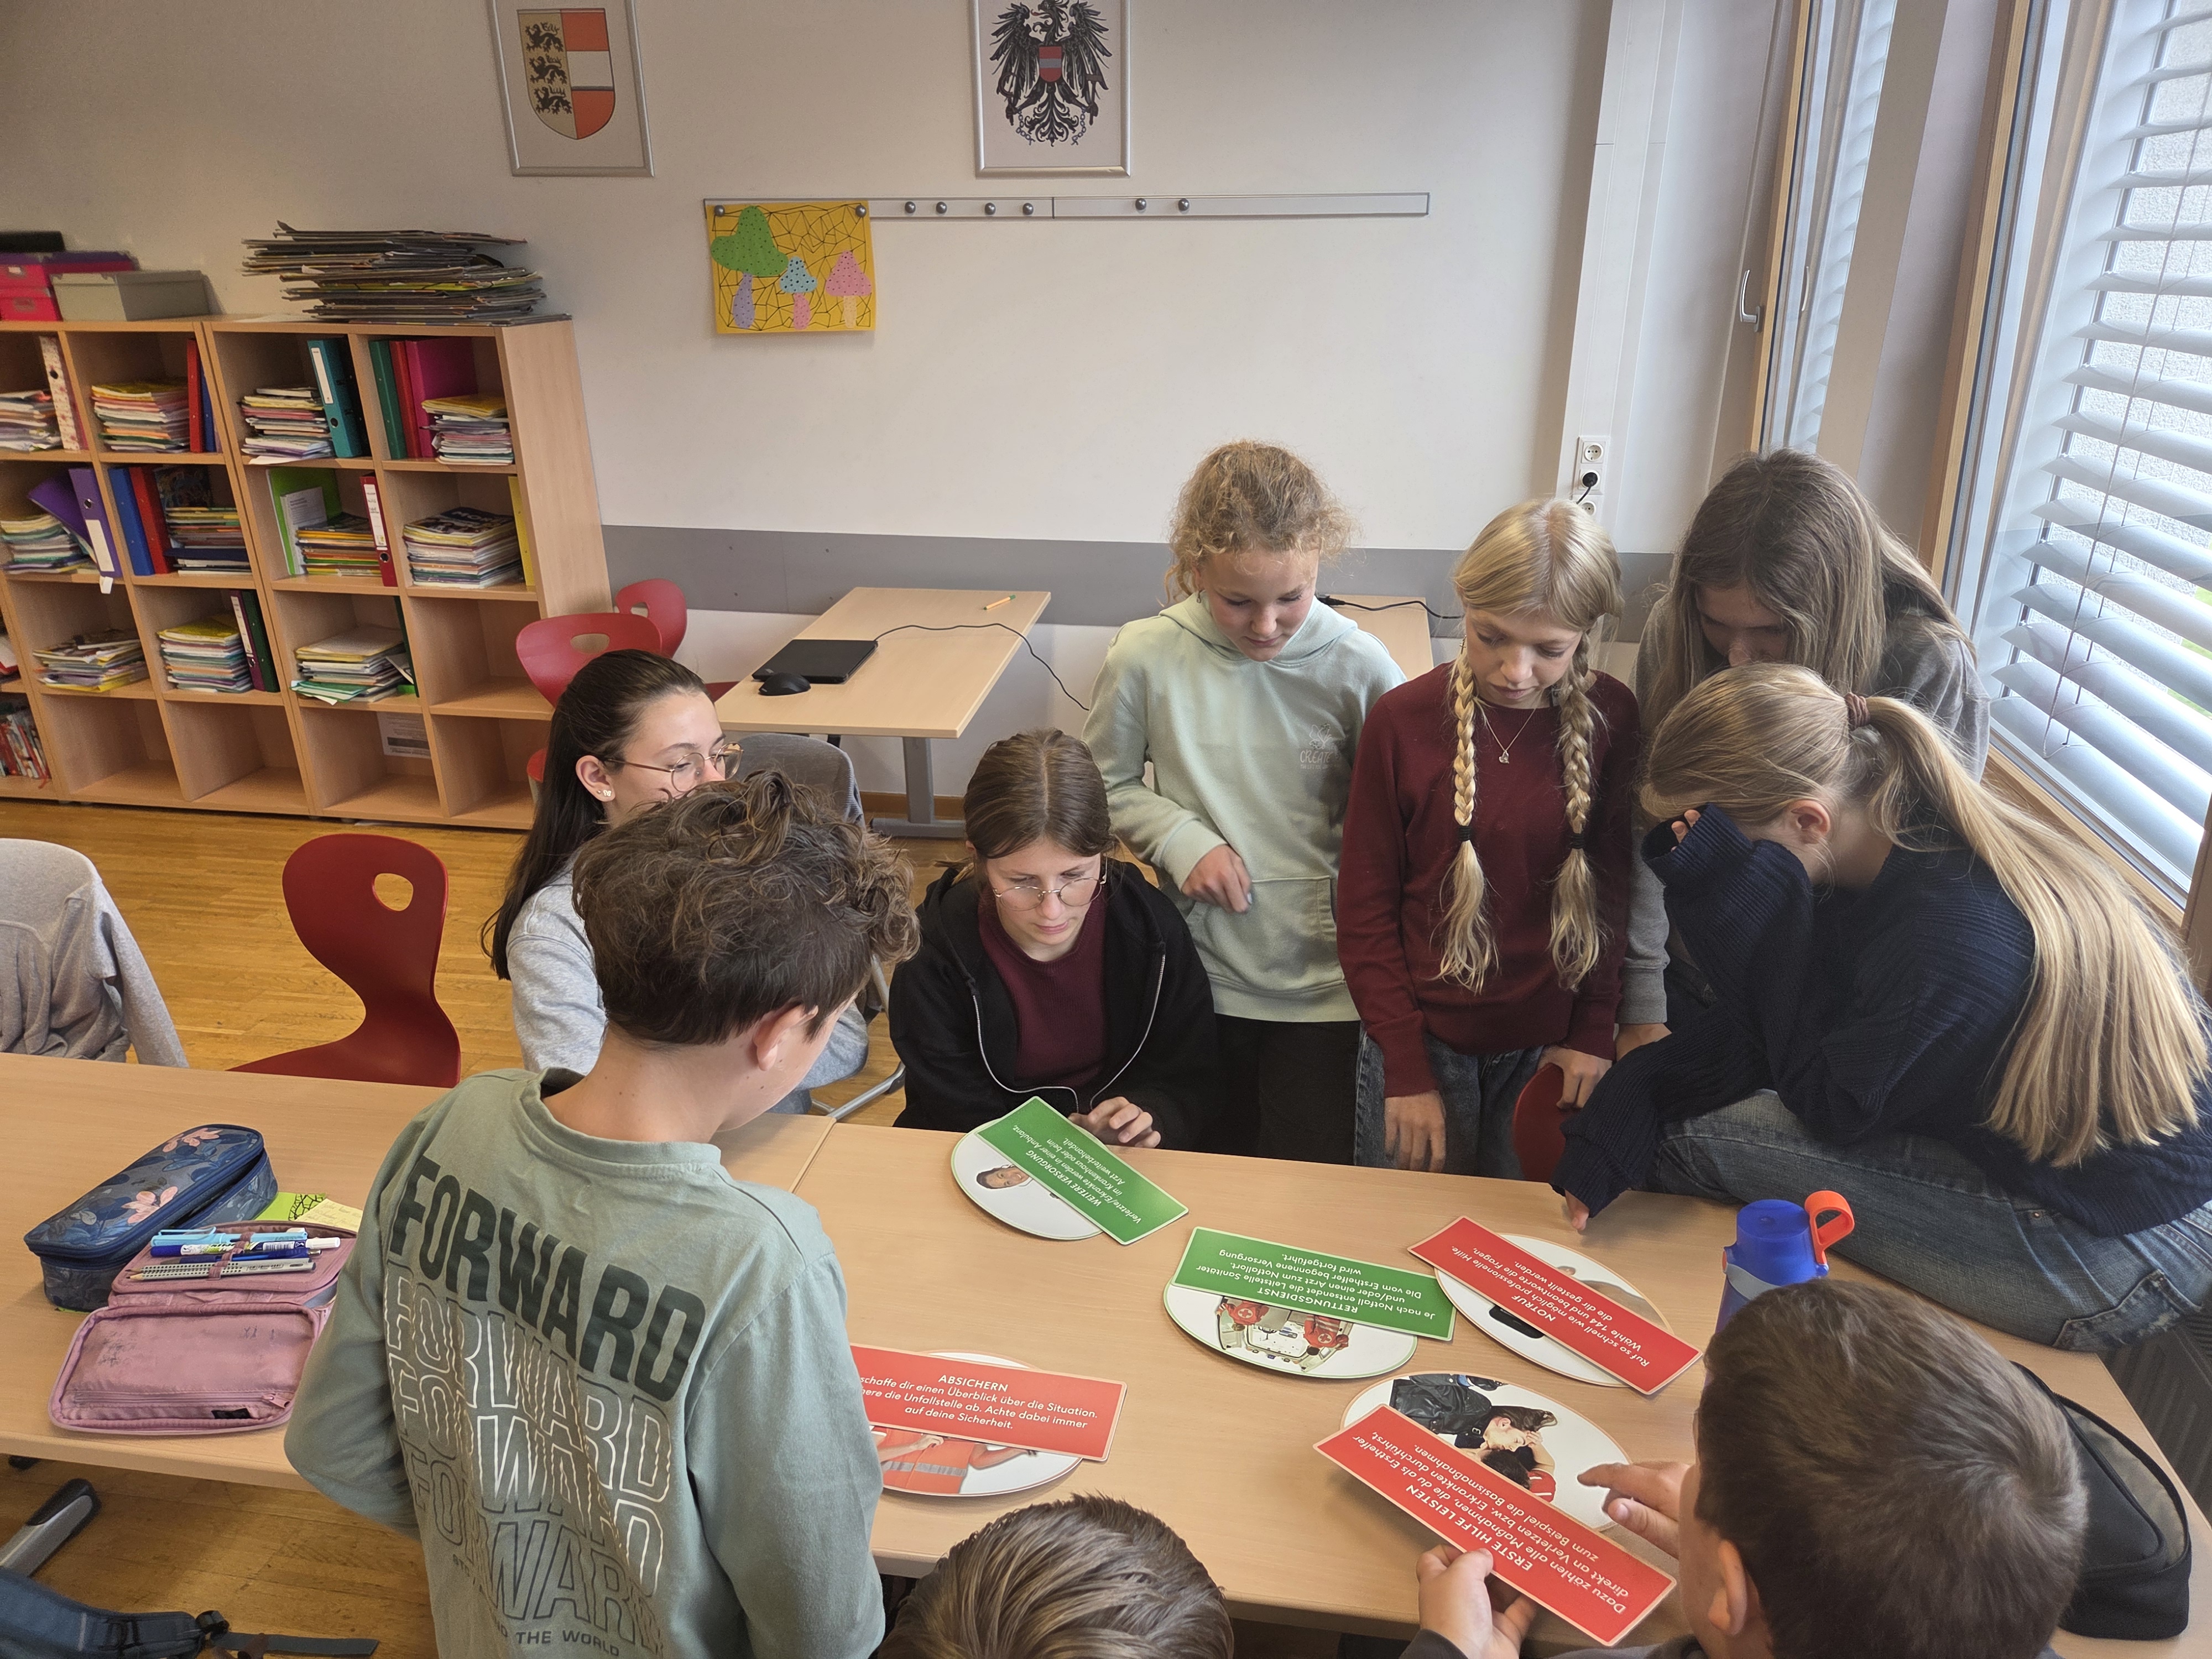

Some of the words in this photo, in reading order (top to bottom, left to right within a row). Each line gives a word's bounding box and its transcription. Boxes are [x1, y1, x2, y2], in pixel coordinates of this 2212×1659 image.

[1300, 749, 1333, 764] CREATE
[1012, 1124, 1043, 1149] Ambulanz,
[1046, 1138, 1063, 1153] beim
[1038, 1146, 1057, 1160] einer
[1054, 1157, 1063, 1165] in
[1060, 1150, 1077, 1162] oder
[1062, 1137, 1112, 1176] weiterbehandelt.
[1025, 1149, 1073, 1186] VERSORGUNG
[1060, 1162, 1084, 1181] werden
[1074, 1160, 1115, 1191] Krankenhaus
[1109, 1173, 1126, 1186] Arzt
[1069, 1182, 1102, 1207] WEITERE
[1082, 1178, 1142, 1224] Verletzte/Erkrankte
[1112, 1187, 1123, 1197] im
[1218, 1249, 1273, 1269] Versorgung
[1281, 1253, 1337, 1272] fortgeführt.
[1451, 1245, 1473, 1262] Hilfe.
[1473, 1247, 1504, 1270] Fragen,
[389, 1155, 706, 1402] FORWARD
[1195, 1265, 1242, 1281] Sanitäter
[1229, 1262, 1280, 1280] Notfallort.
[1275, 1262, 1331, 1281] begonnene
[1281, 1272, 1303, 1282] zum
[1338, 1265, 1362, 1276] wird
[1472, 1259, 1533, 1296] professionelle
[1503, 1266, 1519, 1277] die
[1514, 1261, 1548, 1284] werden.
[1243, 1274, 1287, 1290] Leitstelle
[1288, 1284, 1305, 1293] die
[1304, 1277, 1327, 1288] Arzt
[1328, 1282, 1356, 1293] einen
[1331, 1274, 1380, 1291] Ersthelfer
[1381, 1284, 1404, 1294] vom
[1256, 1286, 1359, 1314] RETTUNGSDIENST
[1306, 1287, 1356, 1302] entsendet
[1356, 1288, 1406, 1303] und/oder
[1405, 1288, 1422, 1300] Die
[1518, 1275, 1571, 1310] beantworte
[1547, 1281, 1584, 1303] gestellt
[1357, 1297, 1394, 1312] Notfall
[1396, 1306, 1422, 1316] nach
[1510, 1295, 1557, 1322] NOTRUF
[1531, 1293, 1568, 1317] möglich
[1568, 1306, 1590, 1319] und
[1580, 1302, 1597, 1312] dir
[1423, 1311, 1436, 1321] Je
[1567, 1315, 1585, 1328] wie
[1589, 1317, 1608, 1332] 144
[1597, 1310, 1613, 1321] die
[1583, 1326, 1620, 1348] schnell
[1610, 1329, 1642, 1353] Wähle
[1619, 1346, 1632, 1355] so
[1629, 1353, 1651, 1368] Ruf
[937, 1374, 1009, 1393] ABSICHERN
[860, 1375, 898, 1388] schaffe
[898, 1380, 916, 1390] dir
[915, 1384, 945, 1395] einen
[947, 1386, 998, 1403] Überblick
[999, 1395, 1026, 1407] über
[1026, 1399, 1045, 1410] die
[1046, 1402, 1098, 1419] Situation.
[884, 1390, 902, 1401] die
[903, 1392, 963, 1410] Unfallstelle
[964, 1402, 983, 1413] ab.
[984, 1405, 1016, 1418] Achte
[1018, 1410, 1051, 1423] dabei
[1052, 1416, 1088, 1429] immer
[904, 1406, 926, 1415] auf
[924, 1407, 956, 1420] deine
[956, 1412, 1014, 1430] Sicherheit.
[1352, 1436, 1401, 1469] Ersthelfer
[1371, 1431, 1430, 1472] durchführst,
[1400, 1465, 1418, 1478] als
[1413, 1444, 1506, 1507] Basismaßnahmen.
[1416, 1477, 1433, 1488] du
[1430, 1470, 1489, 1511] Erkrankten
[1405, 1484, 1457, 1520] LEISTEN
[1432, 1486, 1452, 1500] die
[1490, 1507, 1517, 1530] bzw.
[1506, 1503, 1525, 1517] die
[1453, 1498, 1525, 1550] Maßnahmen,
[1454, 1516, 1493, 1545] HILFE
[1522, 1515, 1571, 1547] Beispiel
[1490, 1540, 1533, 1572] ERSTE
[1525, 1546, 1548, 1563] alle
[1571, 1542, 1599, 1562] zum
[1549, 1561, 1592, 1590] zählen
[1572, 1559, 1590, 1573] an
[1590, 1571, 1629, 1597] direkt
[1591, 1587, 1627, 1614] Dazu
[516, 1630, 552, 1645] THE
[562, 1629, 619, 1657] WORLD
